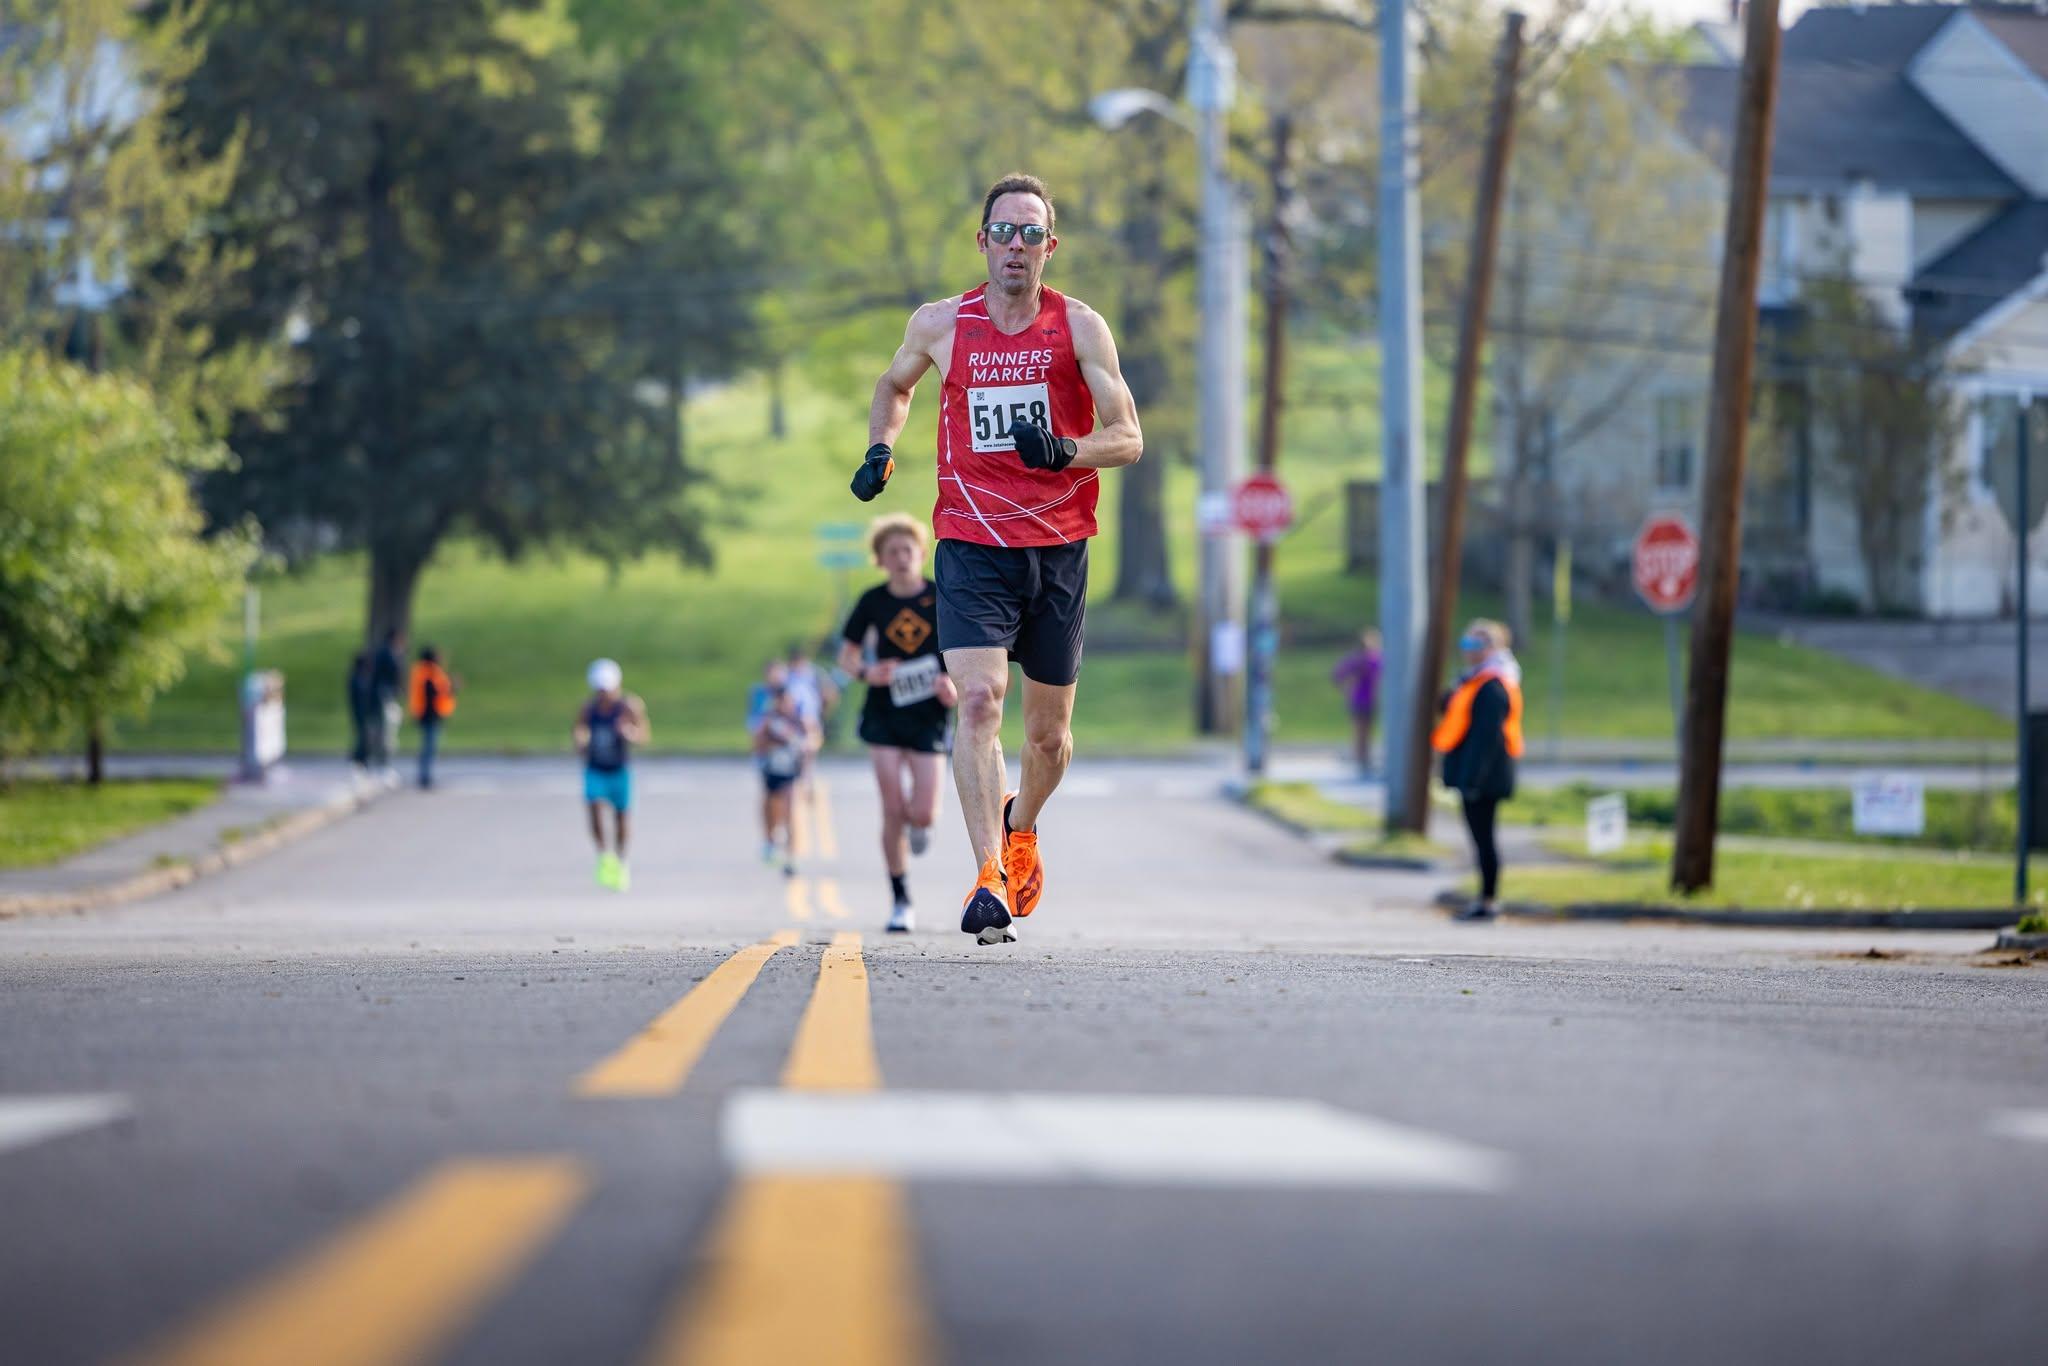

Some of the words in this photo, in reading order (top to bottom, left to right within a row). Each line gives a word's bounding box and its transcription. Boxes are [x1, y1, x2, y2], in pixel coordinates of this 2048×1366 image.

[968, 350, 1053, 367] RUNNERS
[972, 365, 1050, 382] MARKET
[1638, 546, 1696, 579] STOP
